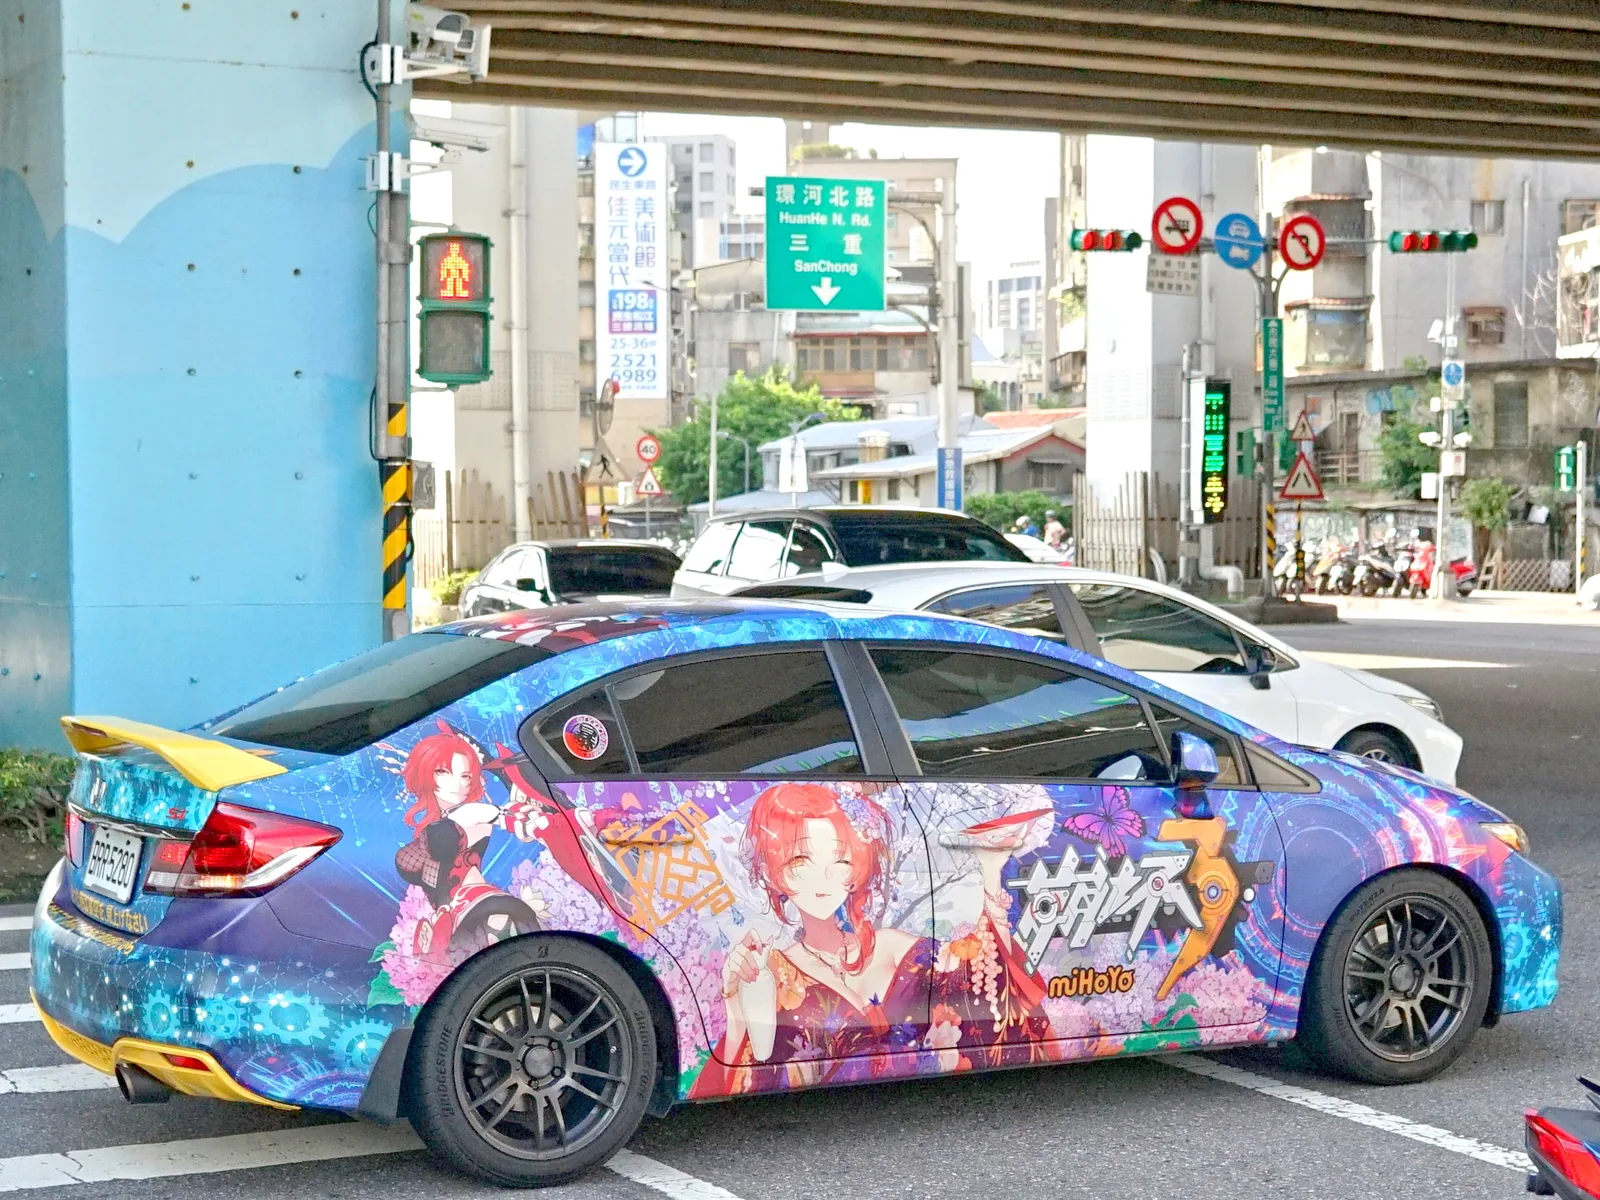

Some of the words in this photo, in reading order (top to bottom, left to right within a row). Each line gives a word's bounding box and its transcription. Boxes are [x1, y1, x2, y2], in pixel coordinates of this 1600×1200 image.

[776, 184, 875, 207] 環河北路
[779, 211, 828, 225] HuanHe
[832, 213, 846, 226] N.
[851, 213, 872, 227] Rd.
[607, 196, 629, 286] 佳元當代
[634, 196, 656, 268] 美術館
[788, 234, 863, 255] 三重
[794, 259, 858, 276] SanChong
[610, 353, 656, 367] 2521
[610, 369, 656, 383] 6989
[641, 445, 656, 454] 40
[1048, 965, 1135, 999] miHoYo
